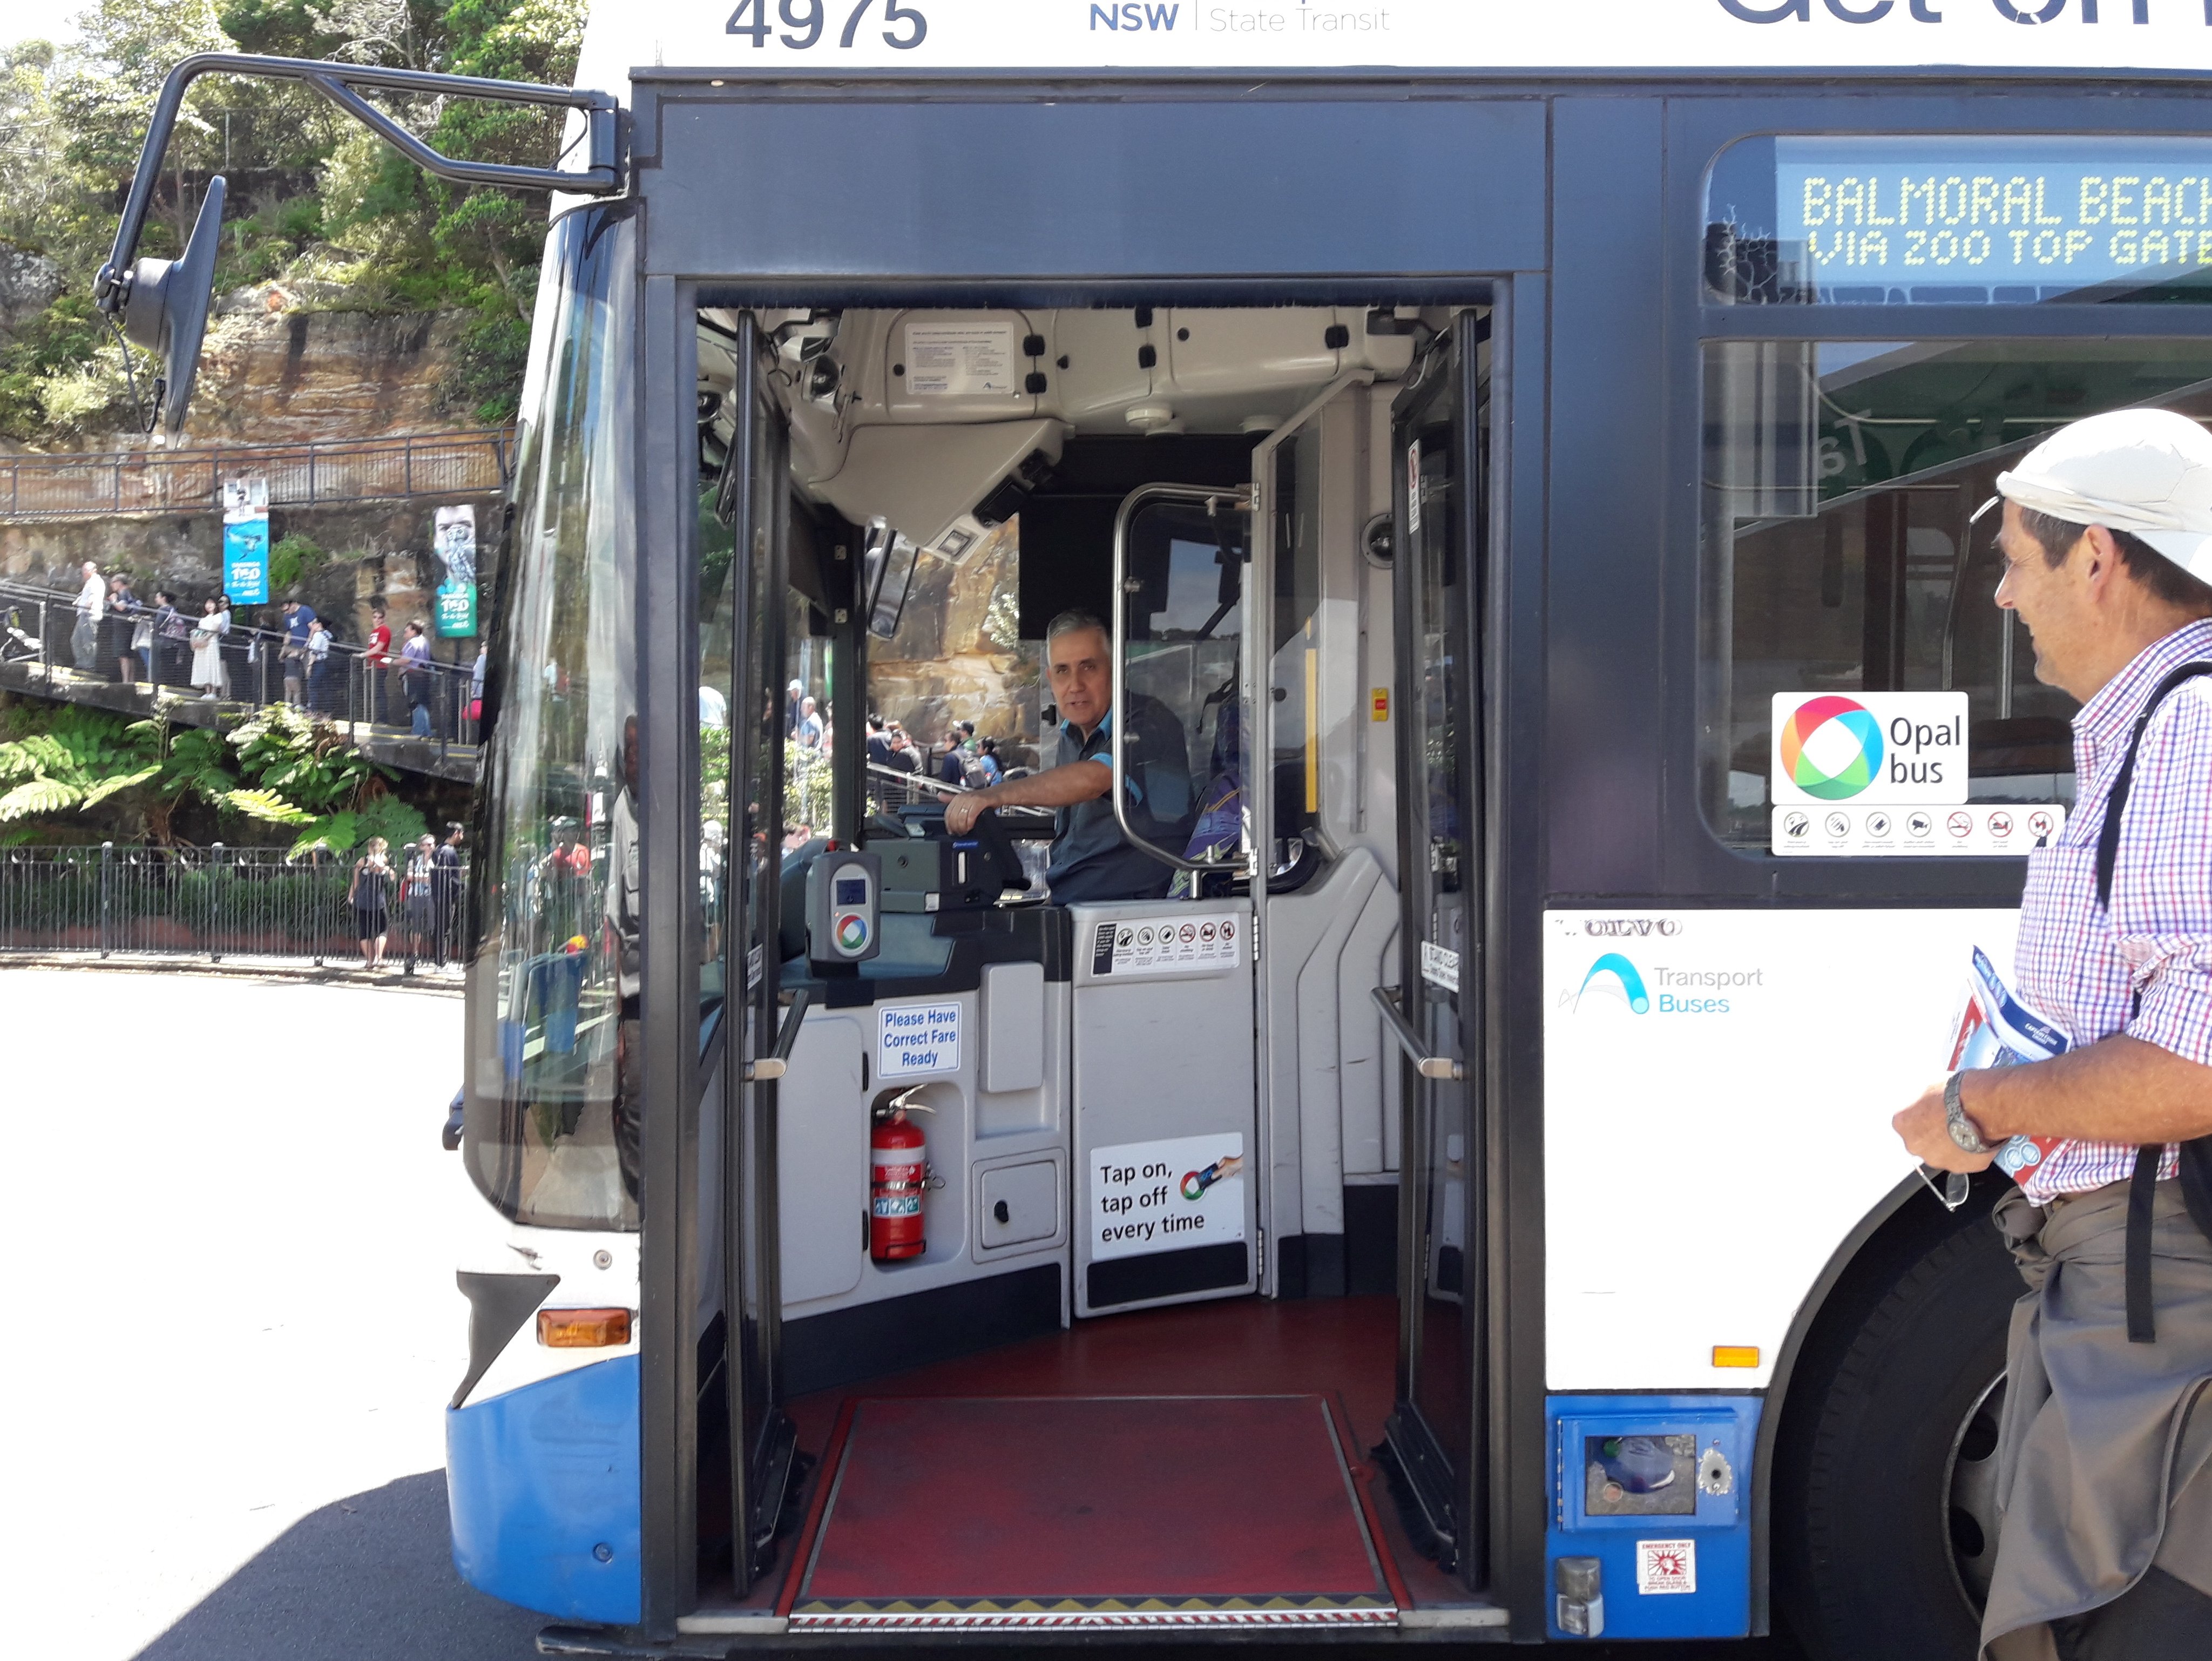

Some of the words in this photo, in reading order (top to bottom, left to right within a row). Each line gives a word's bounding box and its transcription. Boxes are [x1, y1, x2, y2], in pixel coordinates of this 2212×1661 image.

[726, 0, 928, 50] 4975
[1090, 3, 1180, 31] NSW
[1210, 8, 1285, 32] State
[1296, 7, 1390, 31] Transit
[1802, 176, 2062, 226] BALMORAL
[1808, 229, 1888, 266] VIA
[1903, 229, 1991, 266] ZOO
[2007, 229, 2094, 265] TOP
[1890, 715, 1960, 755] Opal
[1890, 753, 1943, 784] bus
[1654, 967, 1763, 991] Transport
[885, 1011, 924, 1028] Please
[928, 1009, 957, 1025] Have
[1659, 994, 1730, 1014] Buses
[884, 1030, 928, 1048] Correct
[931, 1028, 956, 1044] Fare
[902, 1049, 939, 1068] Ready
[1100, 1164, 1136, 1186] Tap
[1142, 1162, 1173, 1179] on,
[1101, 1195, 1133, 1216] tap
[1139, 1185, 1168, 1208] off
[1101, 1221, 1155, 1242] every
[1161, 1213, 1205, 1234] time
